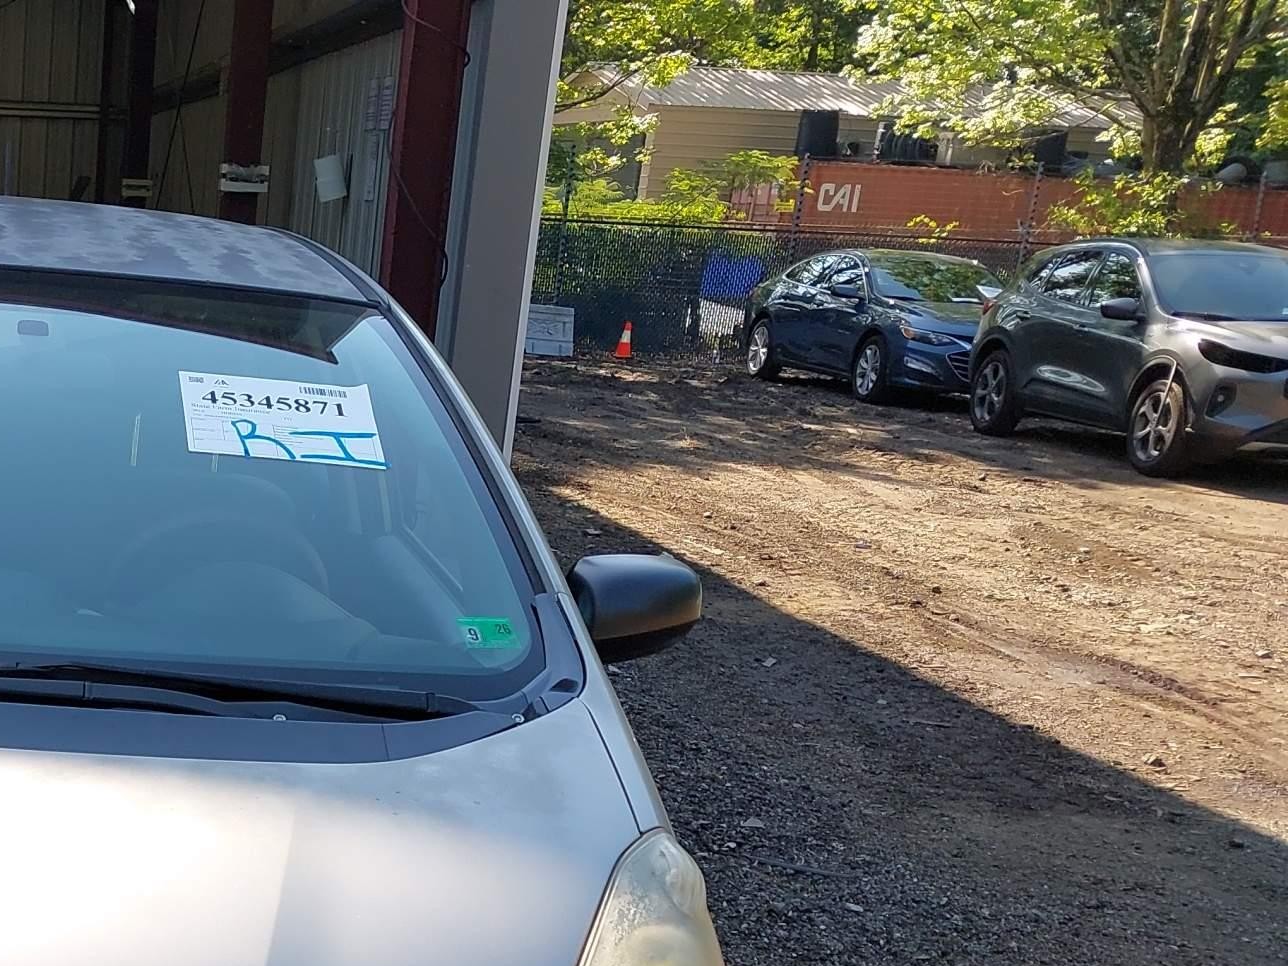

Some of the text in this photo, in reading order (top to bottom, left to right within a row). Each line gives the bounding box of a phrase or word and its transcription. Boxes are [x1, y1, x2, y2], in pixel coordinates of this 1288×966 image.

[817, 183, 862, 213] CAI
[201, 390, 349, 418] 45345871
[467, 627, 480, 642] 9
